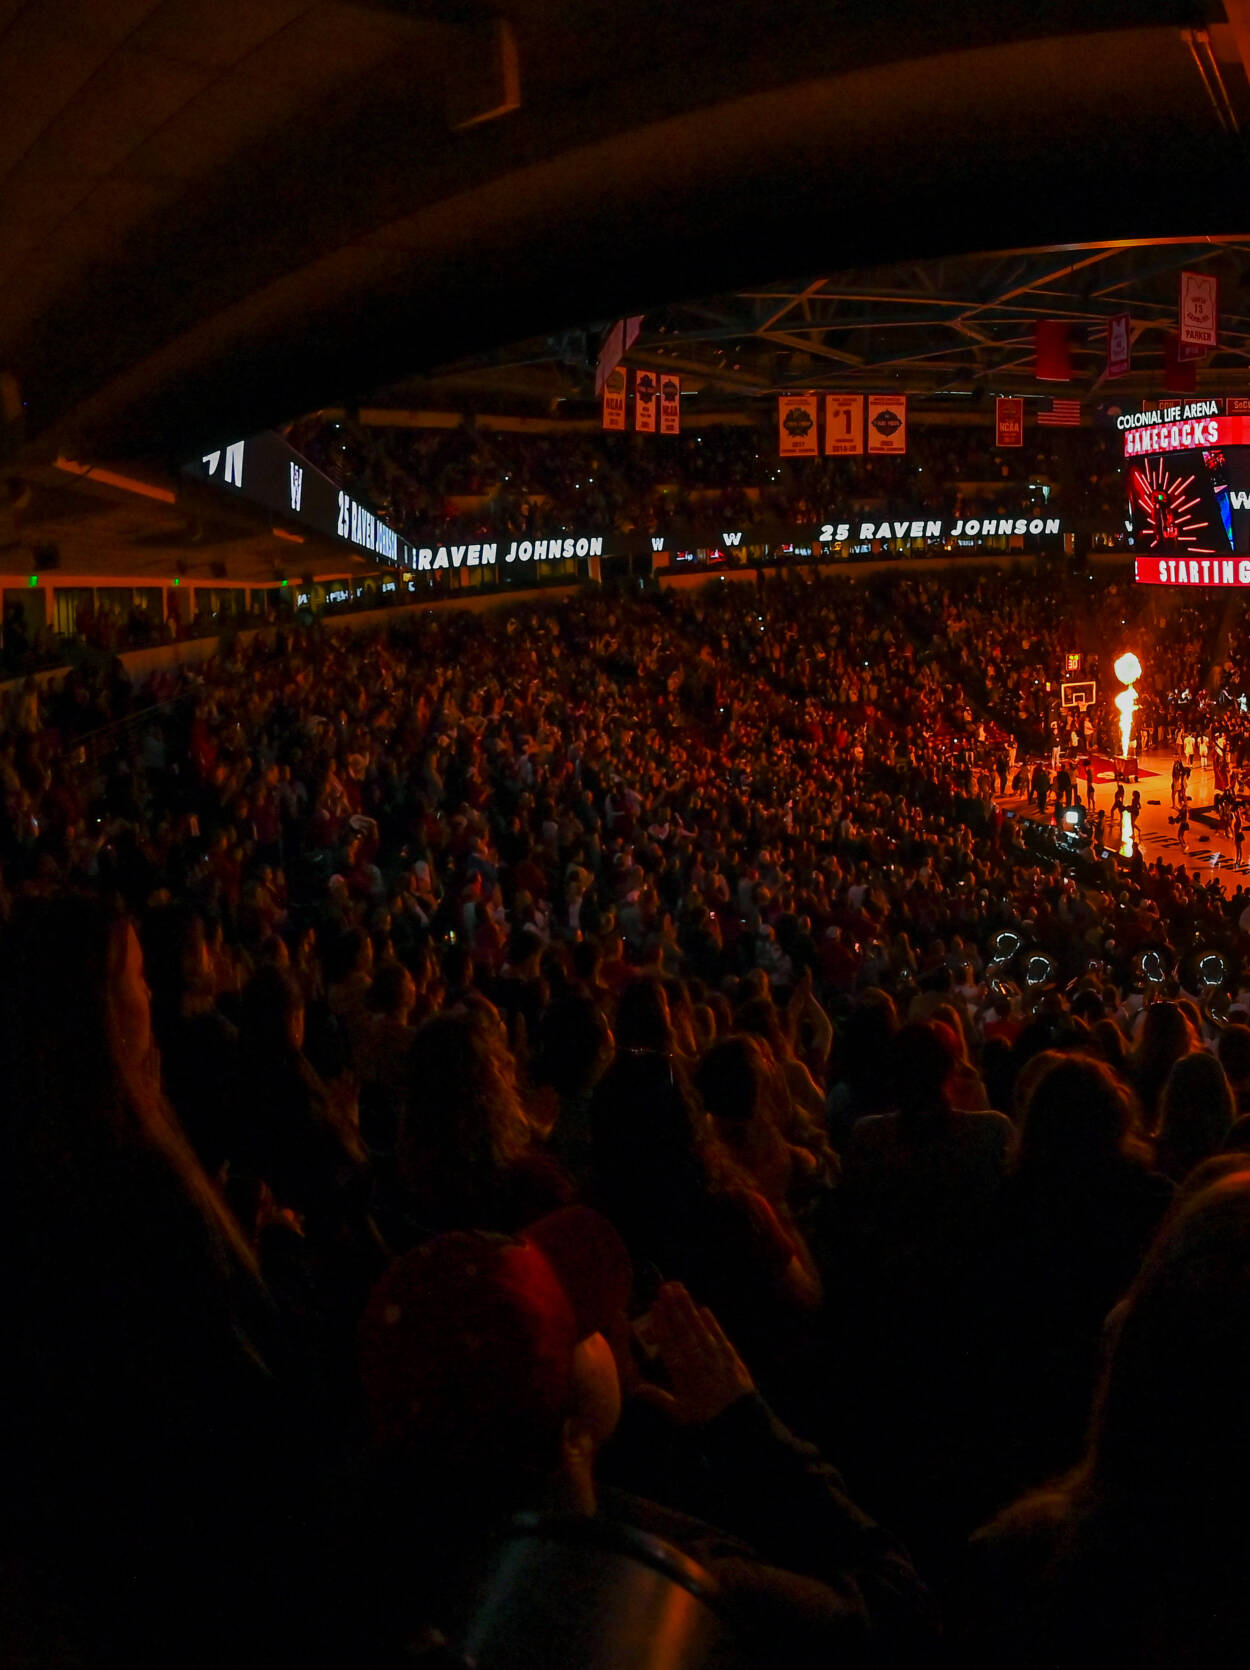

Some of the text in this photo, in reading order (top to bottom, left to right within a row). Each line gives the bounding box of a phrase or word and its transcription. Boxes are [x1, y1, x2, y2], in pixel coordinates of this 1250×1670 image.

[1117, 409, 1162, 429] COLONIAL
[1164, 406, 1181, 422] LIFE
[1183, 400, 1218, 419] ARENA
[1000, 423, 1019, 433] NCAA
[1127, 421, 1218, 453] GAMECOCKS
[337, 490, 350, 539] 25
[722, 532, 742, 546] W
[819, 518, 1061, 542] 25 RAVEN JOHNSON
[418, 543, 497, 571] RAVEN
[505, 537, 603, 563] JOHNSON
[651, 537, 664, 551] W
[1068, 660, 1078, 669] 30
